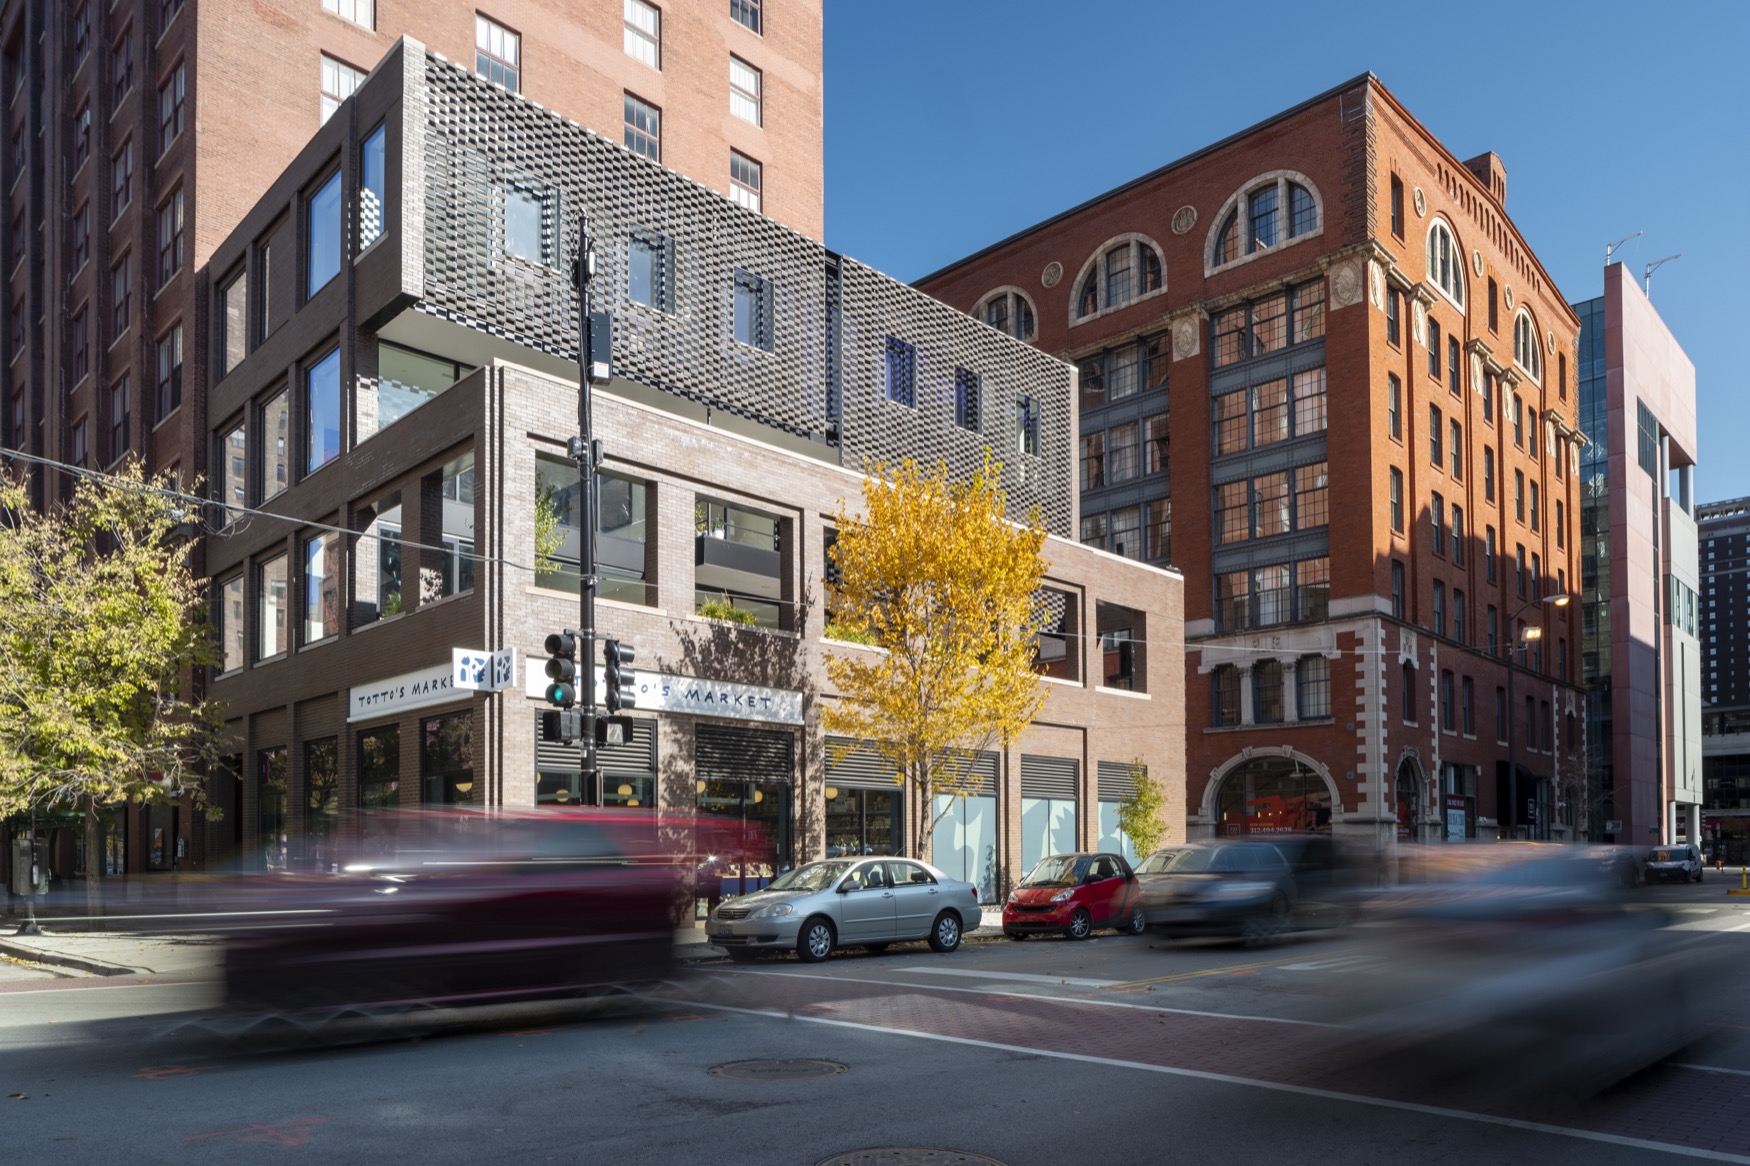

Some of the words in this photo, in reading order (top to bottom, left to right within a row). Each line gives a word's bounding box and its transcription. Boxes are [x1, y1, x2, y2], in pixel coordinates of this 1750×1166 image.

[358, 686, 405, 707] TOTTO'S
[411, 674, 454, 696] MARKE
[685, 689, 771, 709] MARKET
